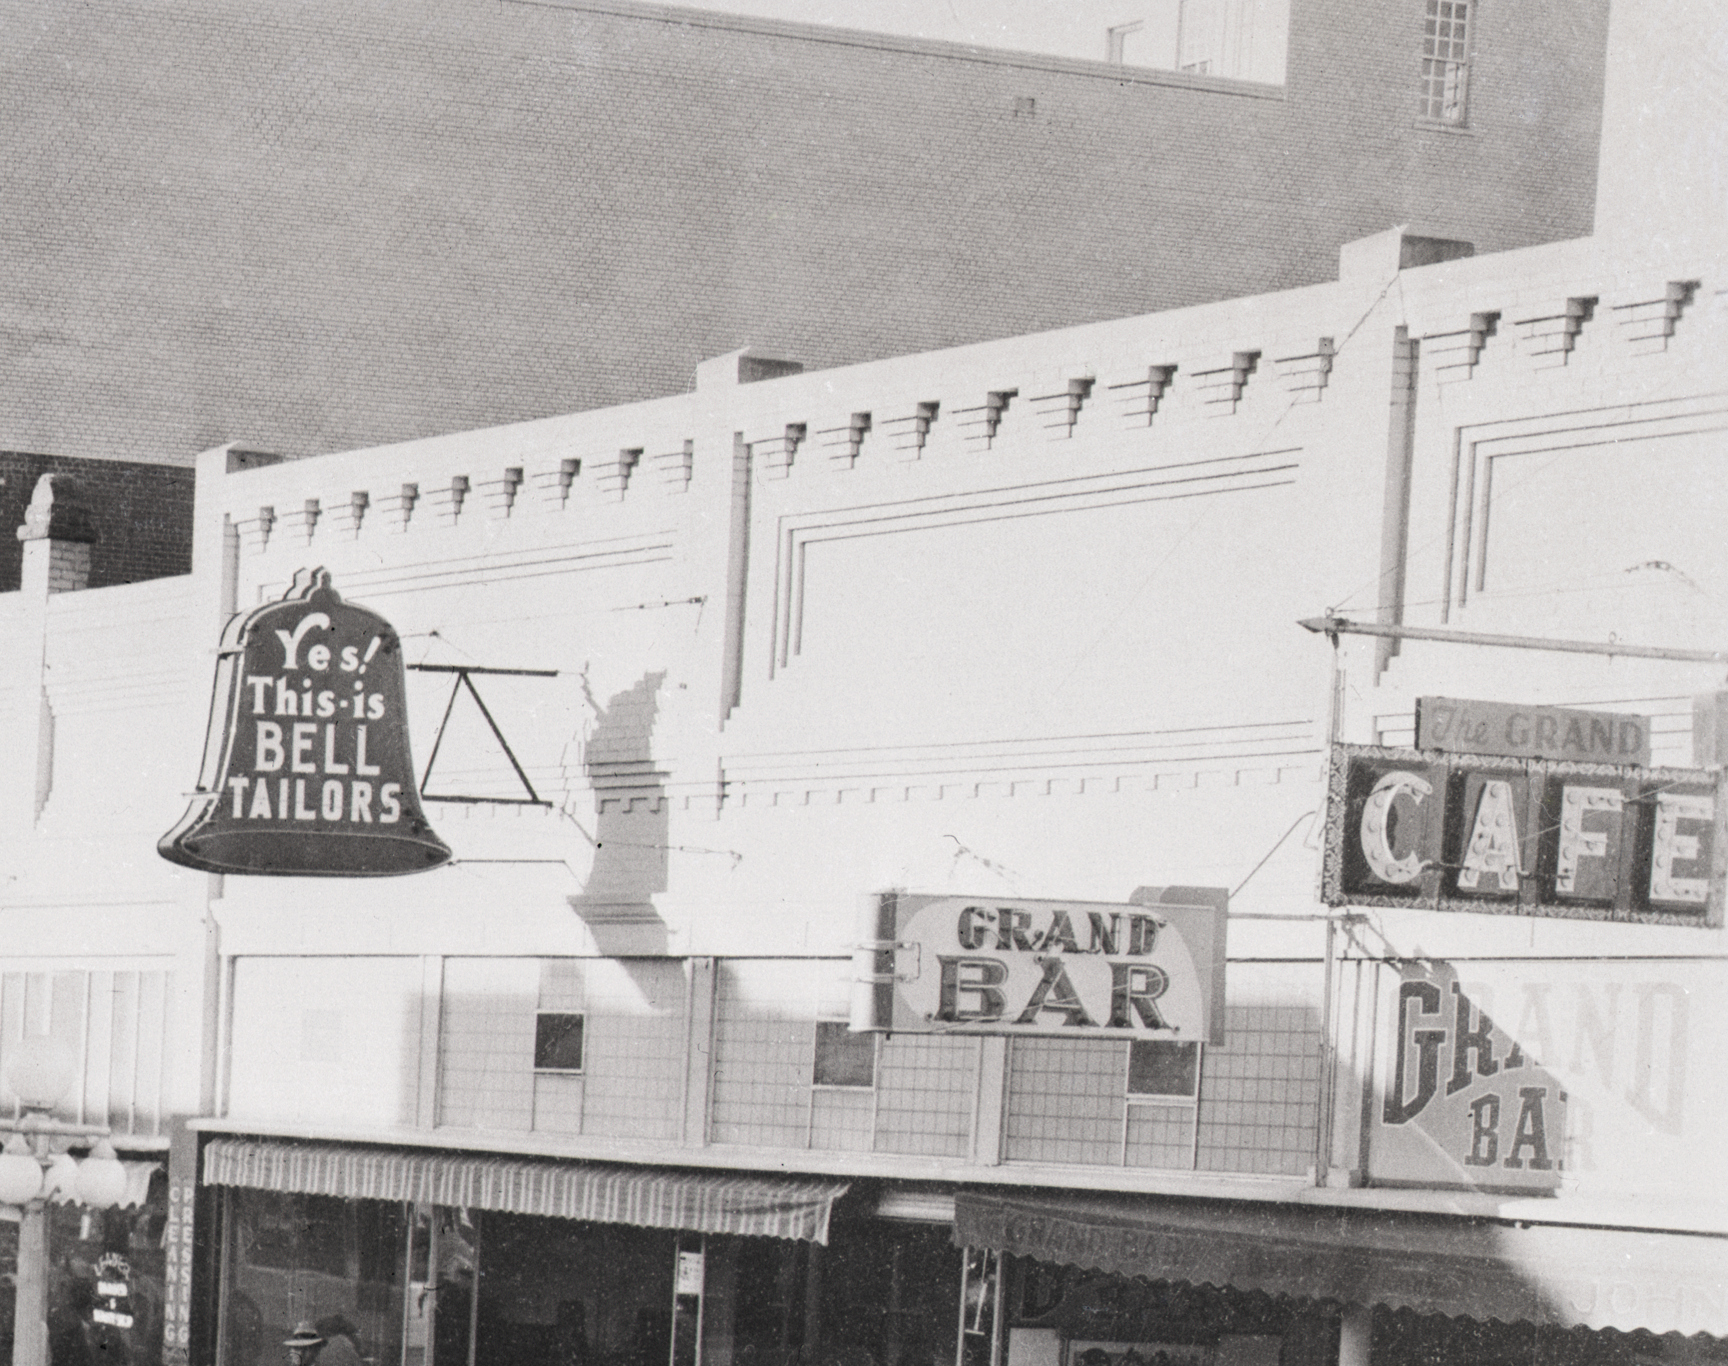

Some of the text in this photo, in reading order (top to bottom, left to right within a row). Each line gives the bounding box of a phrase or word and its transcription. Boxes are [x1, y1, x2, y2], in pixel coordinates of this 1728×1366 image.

[275, 611, 381, 674] Yes!
[254, 720, 381, 776] BELL
[1430, 706, 1643, 756] The GRAND
[228, 776, 401, 824] TAILORS
[1360, 771, 1715, 903] CAFE
[957, 905, 1164, 956] GRAND
[933, 954, 1172, 1030] BAR
[1383, 980, 1691, 1137] GRAND
[1465, 1086, 1596, 1171] BAR
[164, 1185, 180, 1343] CLEANING
[178, 1186, 194, 1344] PRESSING
